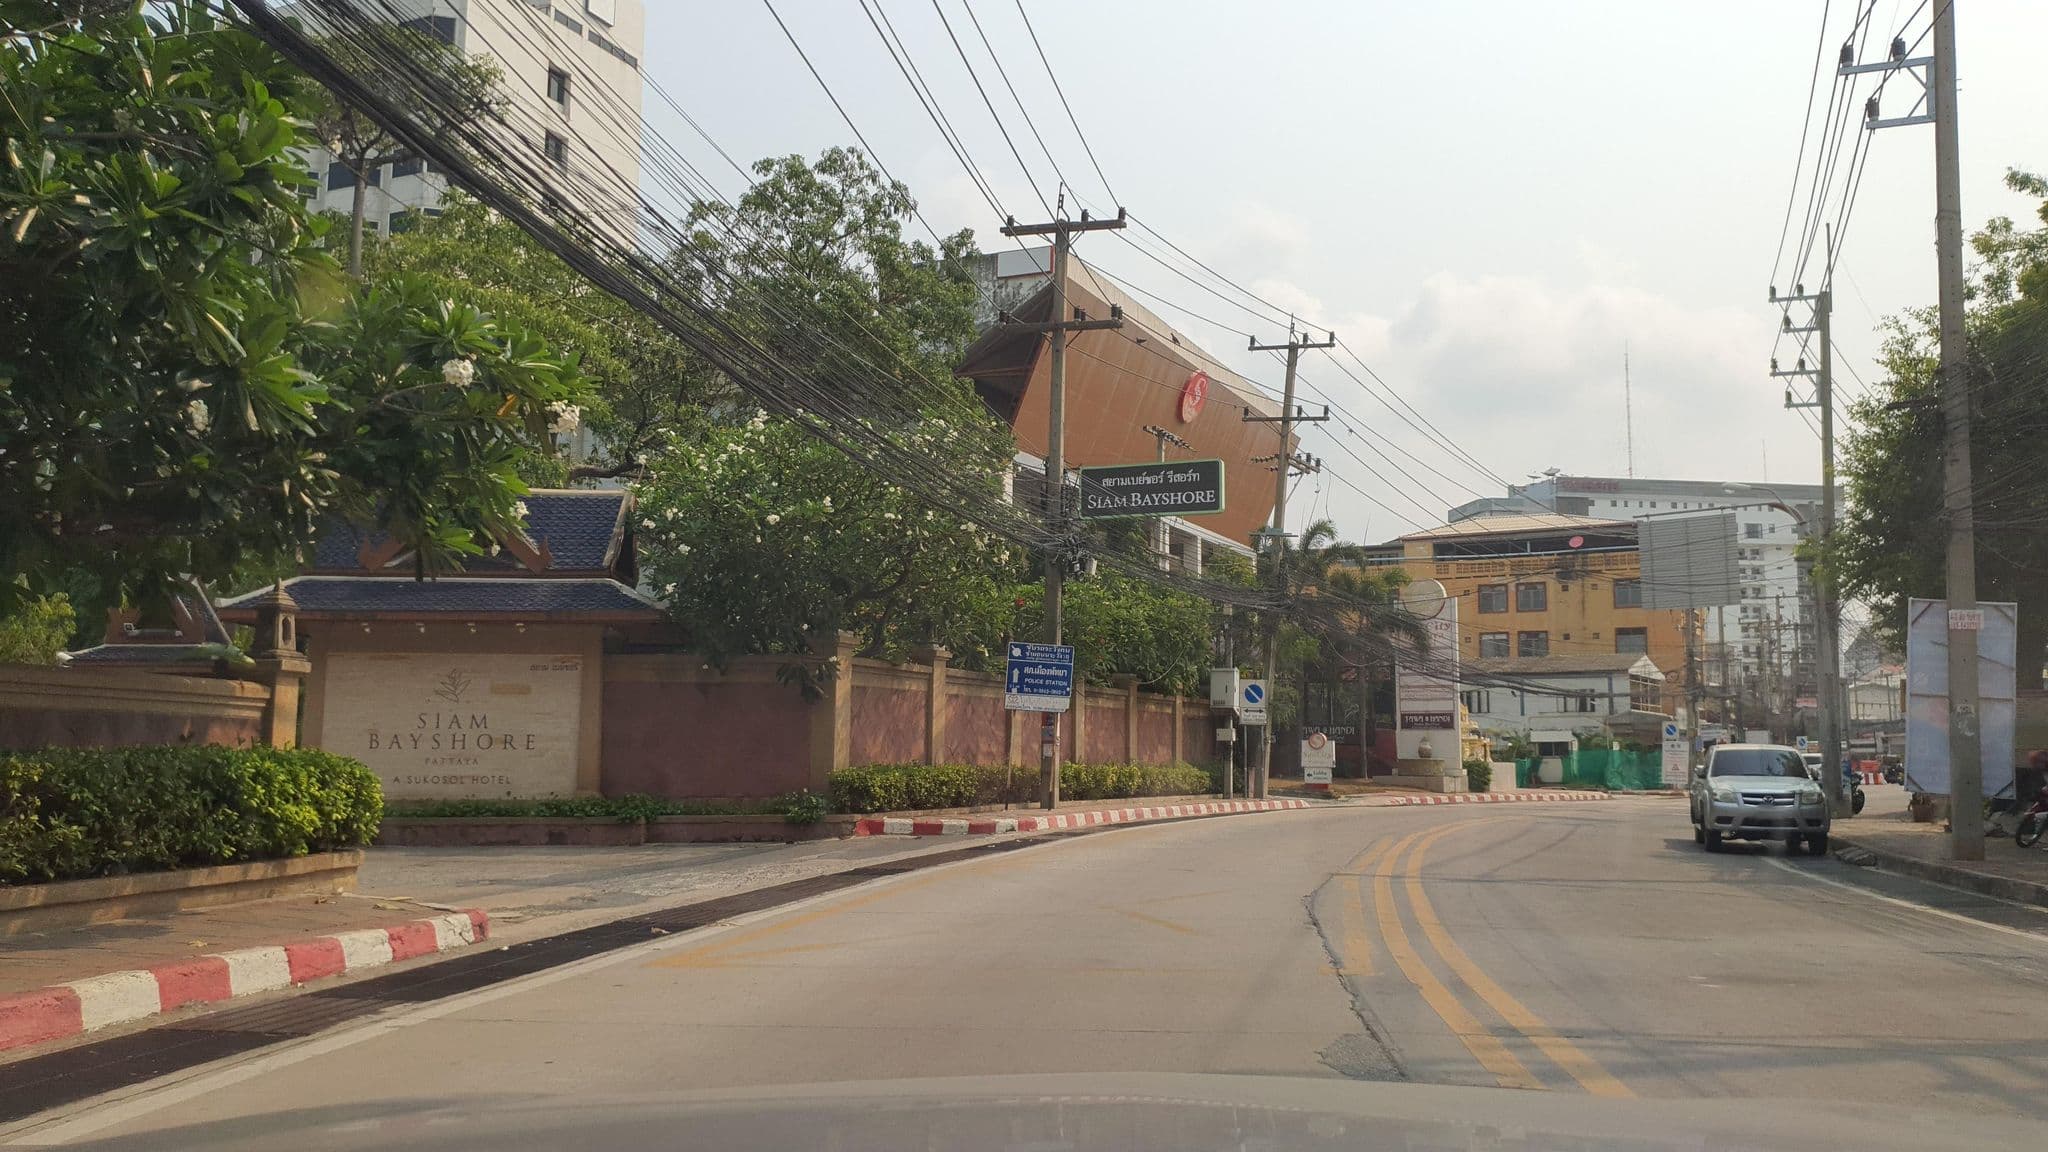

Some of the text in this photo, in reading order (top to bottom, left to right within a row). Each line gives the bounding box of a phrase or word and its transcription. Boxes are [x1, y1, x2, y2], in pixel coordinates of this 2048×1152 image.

[1087, 490, 1215, 509] SIAM BAYSHORE
[417, 712, 489, 730] SIAM
[369, 733, 536, 750] BAYSHORE
[425, 757, 479, 766] PATTAYA
[393, 775, 512, 785] A SUKOSOL HOTEL
